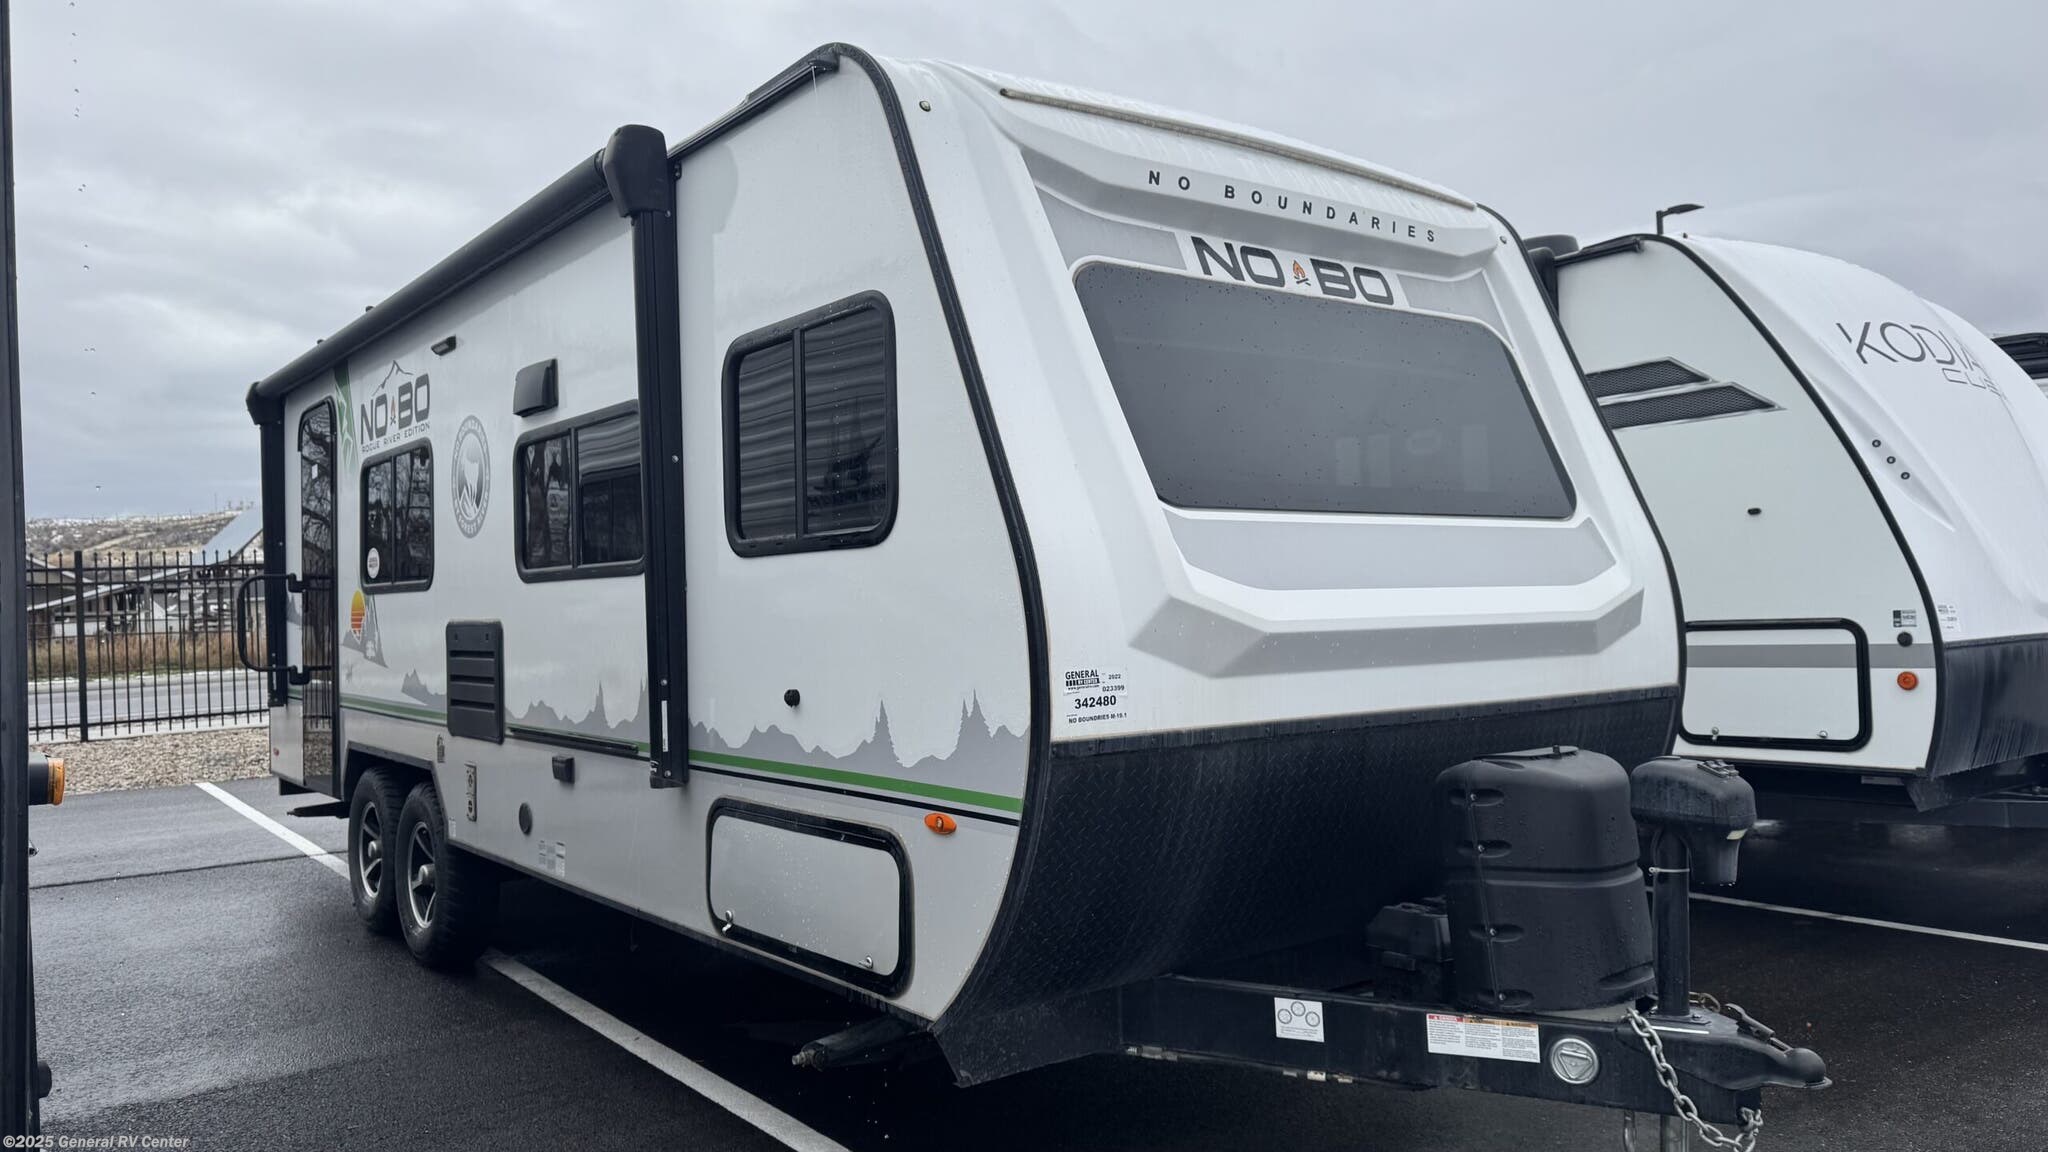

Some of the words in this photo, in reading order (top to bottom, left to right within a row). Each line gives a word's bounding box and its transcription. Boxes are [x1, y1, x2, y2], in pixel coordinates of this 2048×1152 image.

[1148, 170, 1191, 190] NO
[1224, 185, 1435, 243] BOUNDARIES
[361, 440, 381, 453] ROGUE
[383, 432, 401, 445] RIVER
[404, 422, 430, 439] EDITION
[1065, 669, 1099, 680] GENERAL
[1074, 695, 1117, 710] 342480
